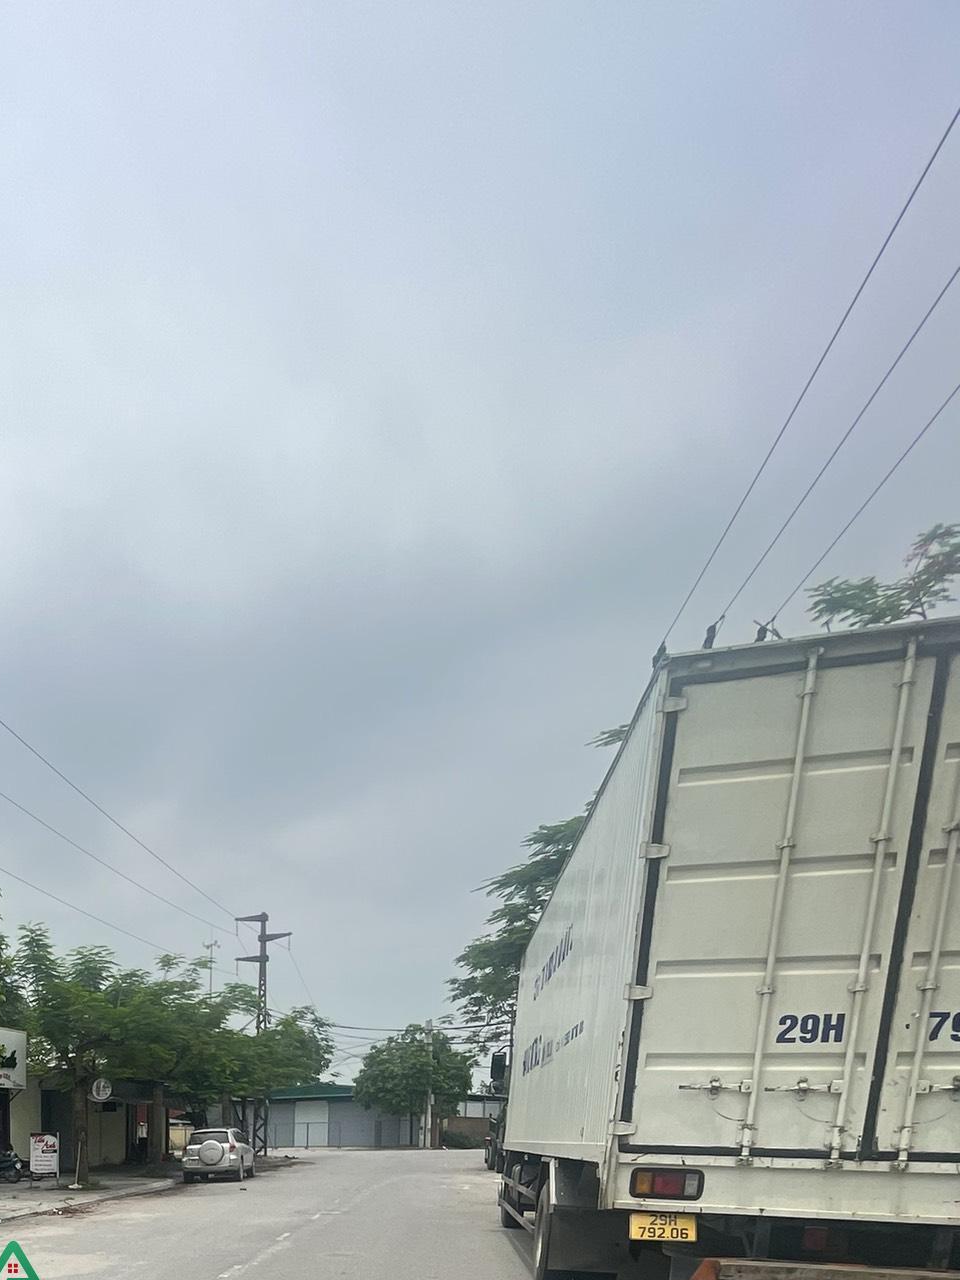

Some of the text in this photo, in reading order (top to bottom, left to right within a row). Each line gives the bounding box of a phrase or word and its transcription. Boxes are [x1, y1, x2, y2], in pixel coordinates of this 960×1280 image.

[775, 1013, 846, 1044] 29H
[649, 1214, 677, 1226] 29H
[638, 1226, 689, 1239] 792.06
